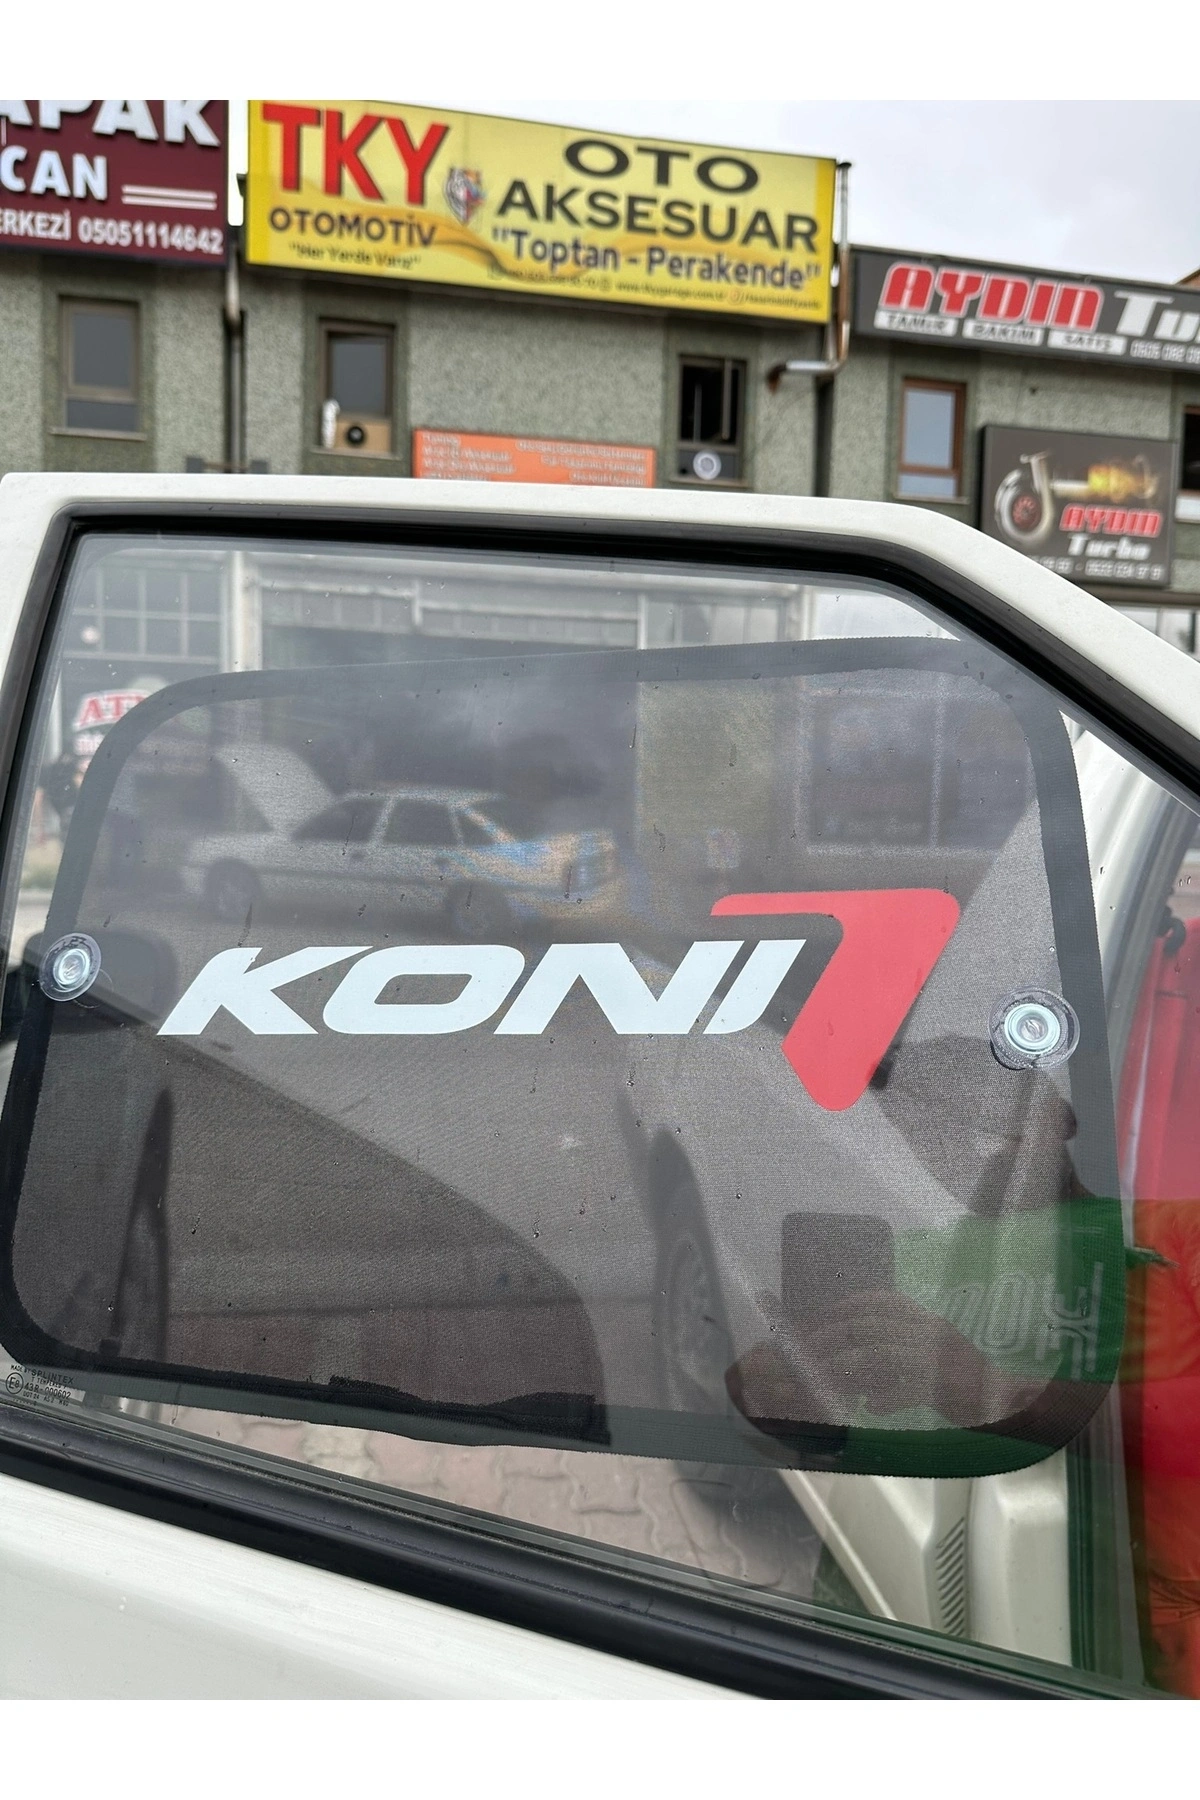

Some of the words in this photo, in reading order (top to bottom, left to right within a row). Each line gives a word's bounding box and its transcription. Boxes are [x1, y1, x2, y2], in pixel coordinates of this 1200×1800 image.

[262, 102, 447, 206] TKY
[565, 139, 759, 194] OTO
[0, 208, 72, 241] RKEZİ
[78, 216, 224, 255] 05051114642
[269, 206, 436, 248] OTOMOTİV
[497, 180, 819, 254] AKSESUAR
[492, 226, 620, 274] "Toptan
[647, 246, 822, 291] Perakende"
[878, 260, 1105, 332] AYDIN
[1114, 290, 1200, 343] Tu
[1058, 503, 1163, 539] AYDIN
[1067, 532, 1153, 561] Turbo
[156, 938, 807, 1037] KONI
[9, 1376, 20, 1389] E8
[24, 1381, 72, 1400] 43R-000602
[31, 1368, 74, 1385] SPLINTEX
